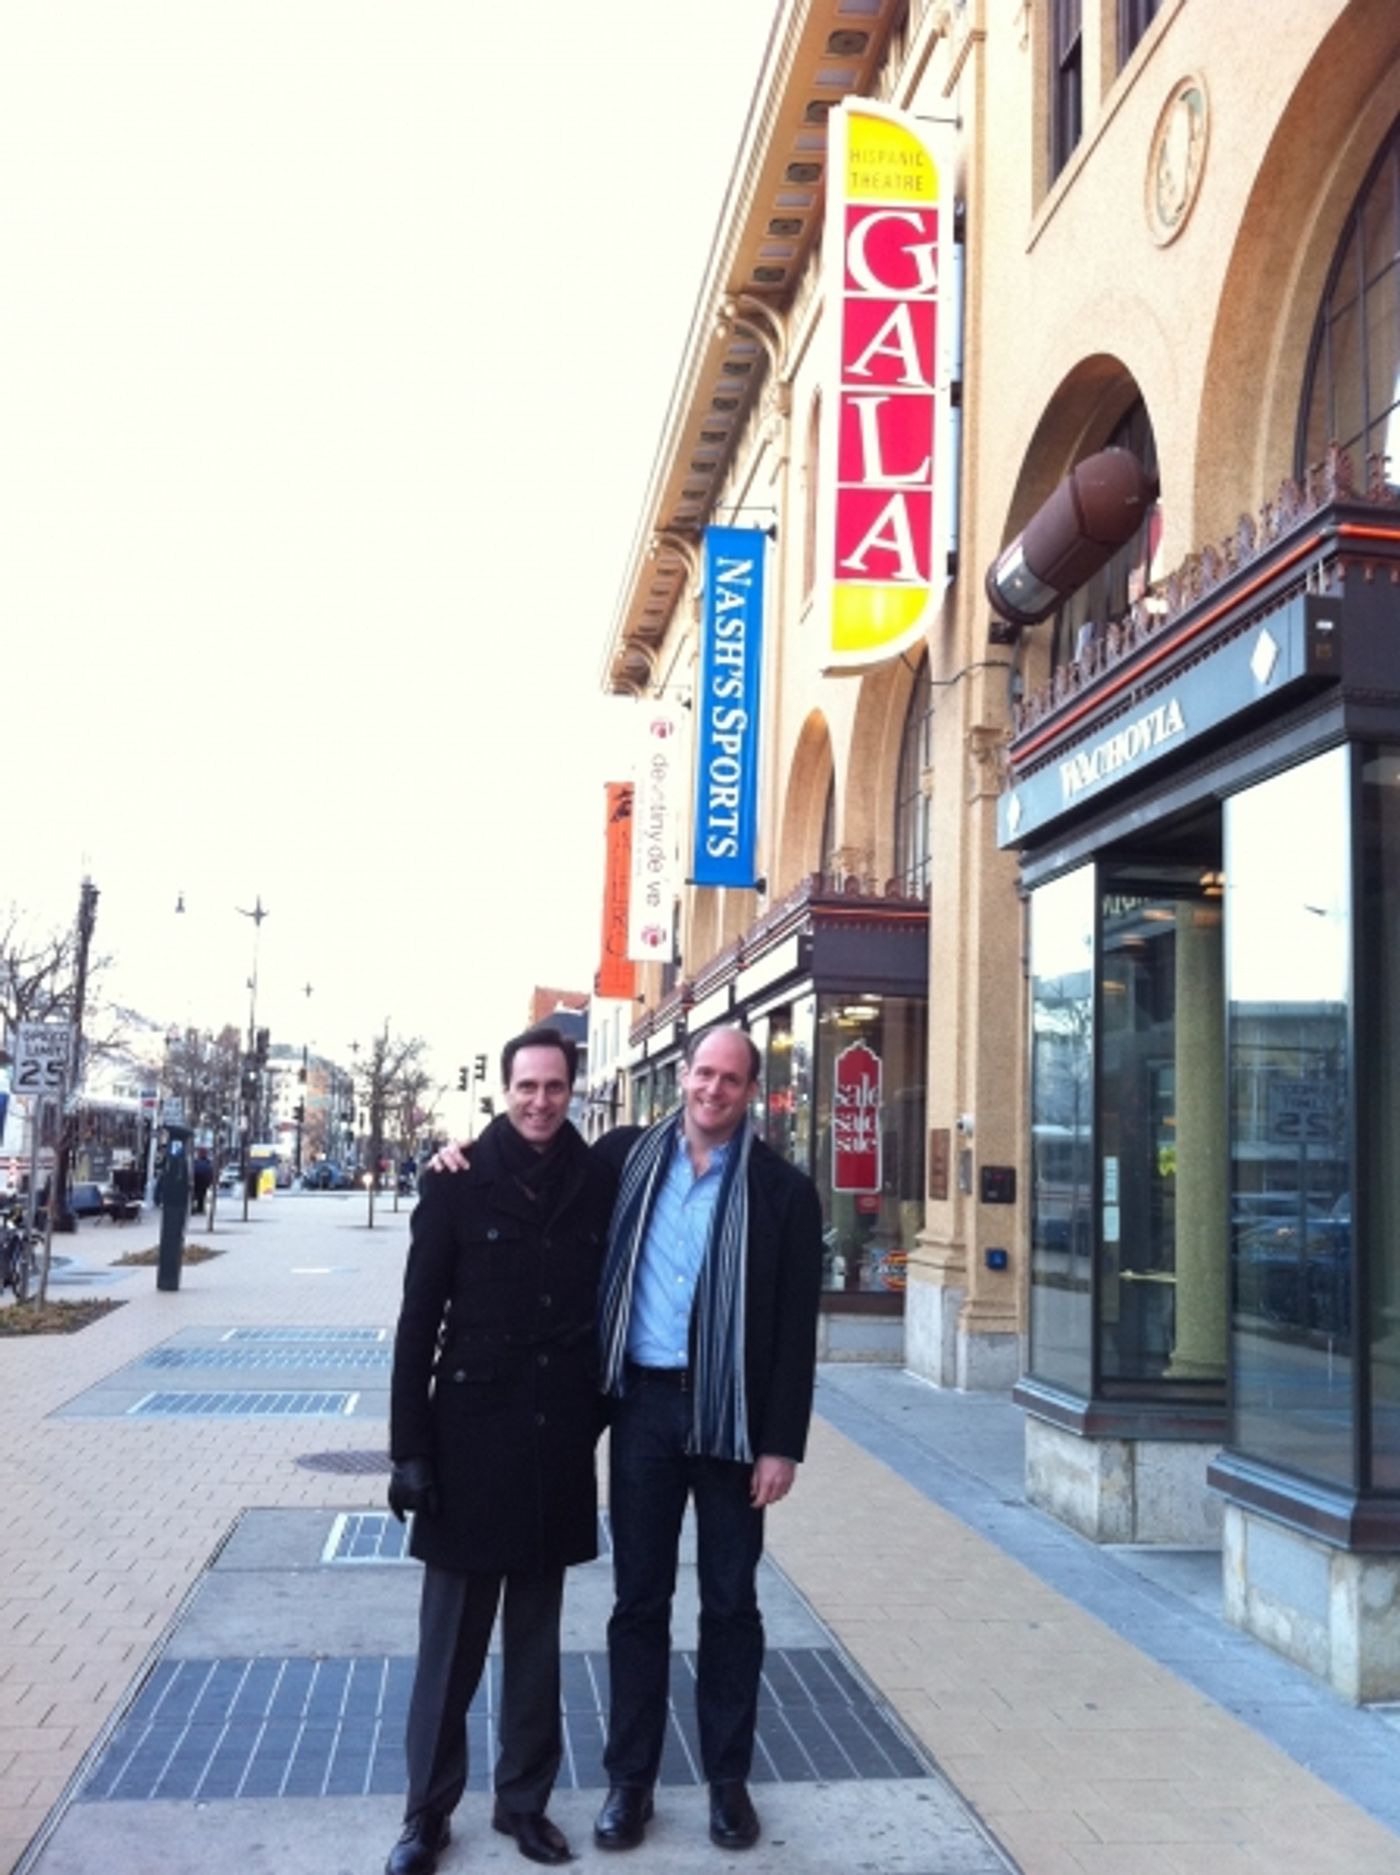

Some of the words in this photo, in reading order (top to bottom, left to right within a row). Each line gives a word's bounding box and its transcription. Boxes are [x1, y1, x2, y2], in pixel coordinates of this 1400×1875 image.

[849, 149, 924, 168] HISPANIC
[851, 172, 924, 193] THEATRE
[840, 209, 938, 583] GALA
[712, 556, 753, 699] NASH'S
[706, 706, 748, 858] SPORTS
[1060, 697, 1185, 799] WACHOVIA
[19, 1060, 65, 1086] 25
[834, 1072, 879, 1107] sale
